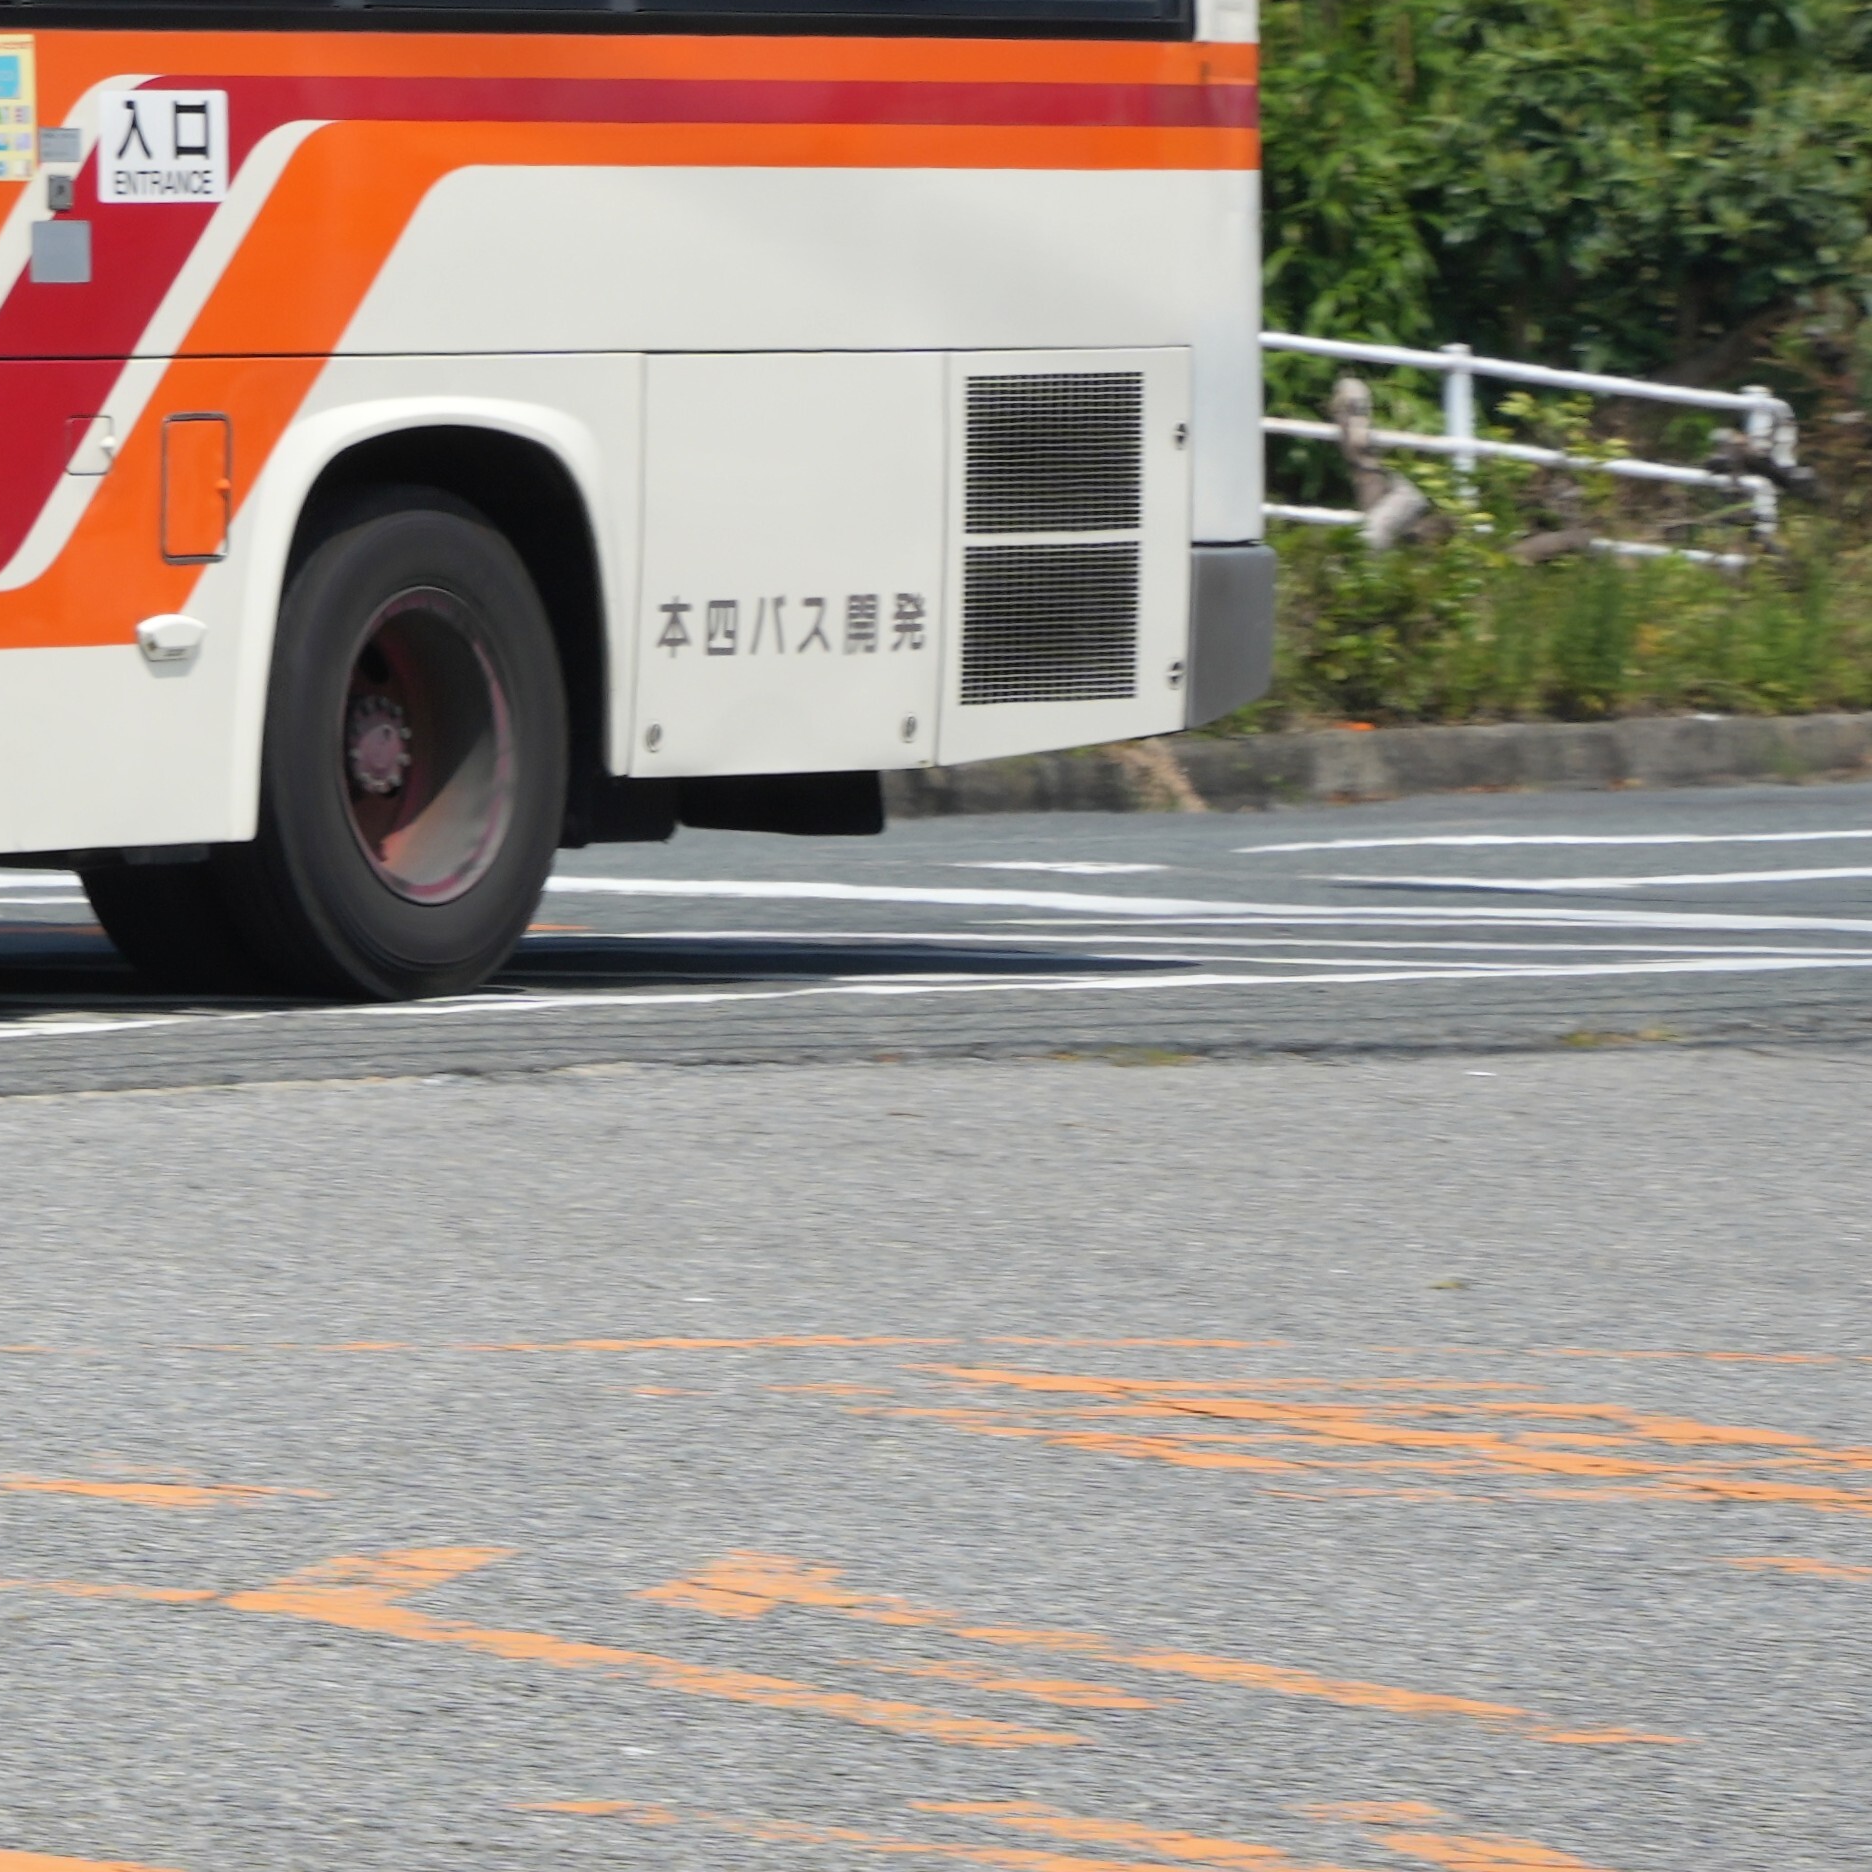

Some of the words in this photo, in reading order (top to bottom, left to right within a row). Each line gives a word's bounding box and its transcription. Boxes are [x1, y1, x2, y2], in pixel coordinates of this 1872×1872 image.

[116, 99, 210, 160] 入口
[114, 169, 214, 196] ENTRANCE
[655, 592, 926, 659] 本四バス開発
